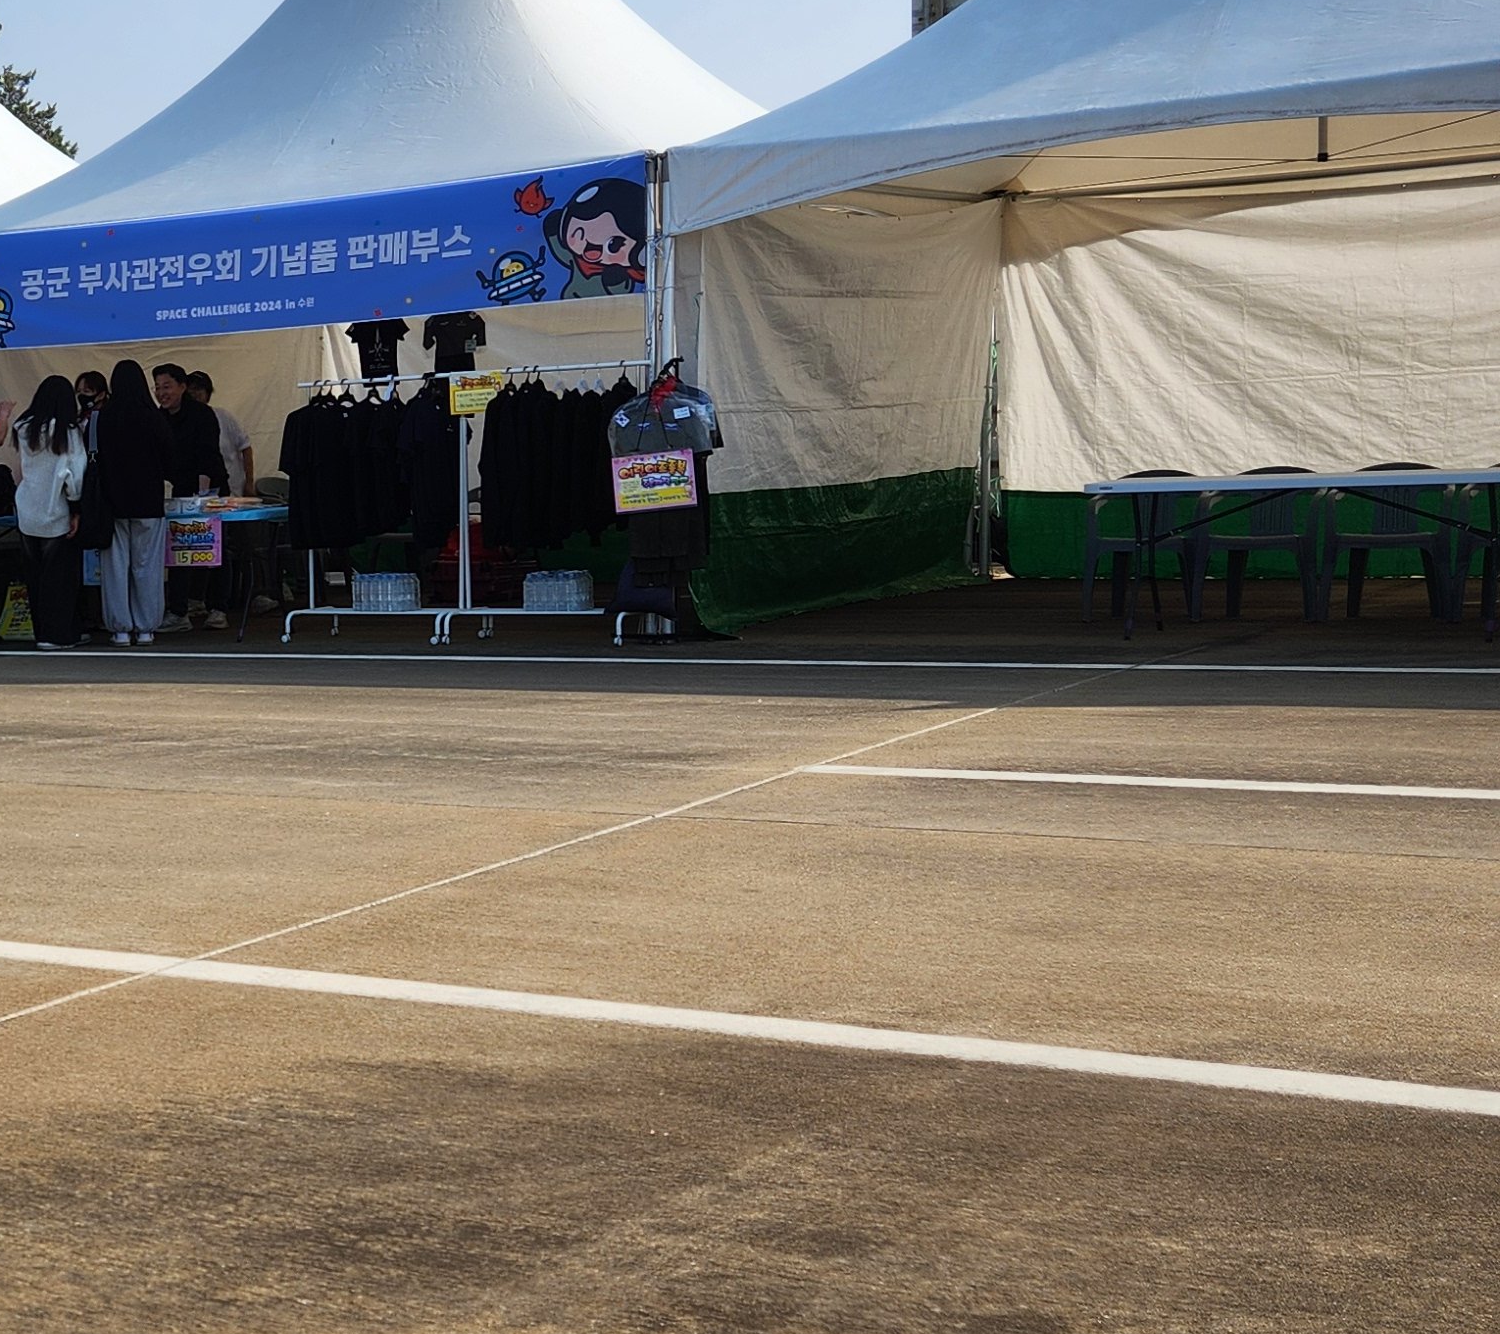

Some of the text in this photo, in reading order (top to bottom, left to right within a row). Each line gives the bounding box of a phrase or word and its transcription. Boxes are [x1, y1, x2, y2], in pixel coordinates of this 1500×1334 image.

[20, 224, 473, 301] 공군 부사관전우회 기념품 판매부스
[156, 296, 315, 321] SPACE CHALLENGE 2024 in 수원
